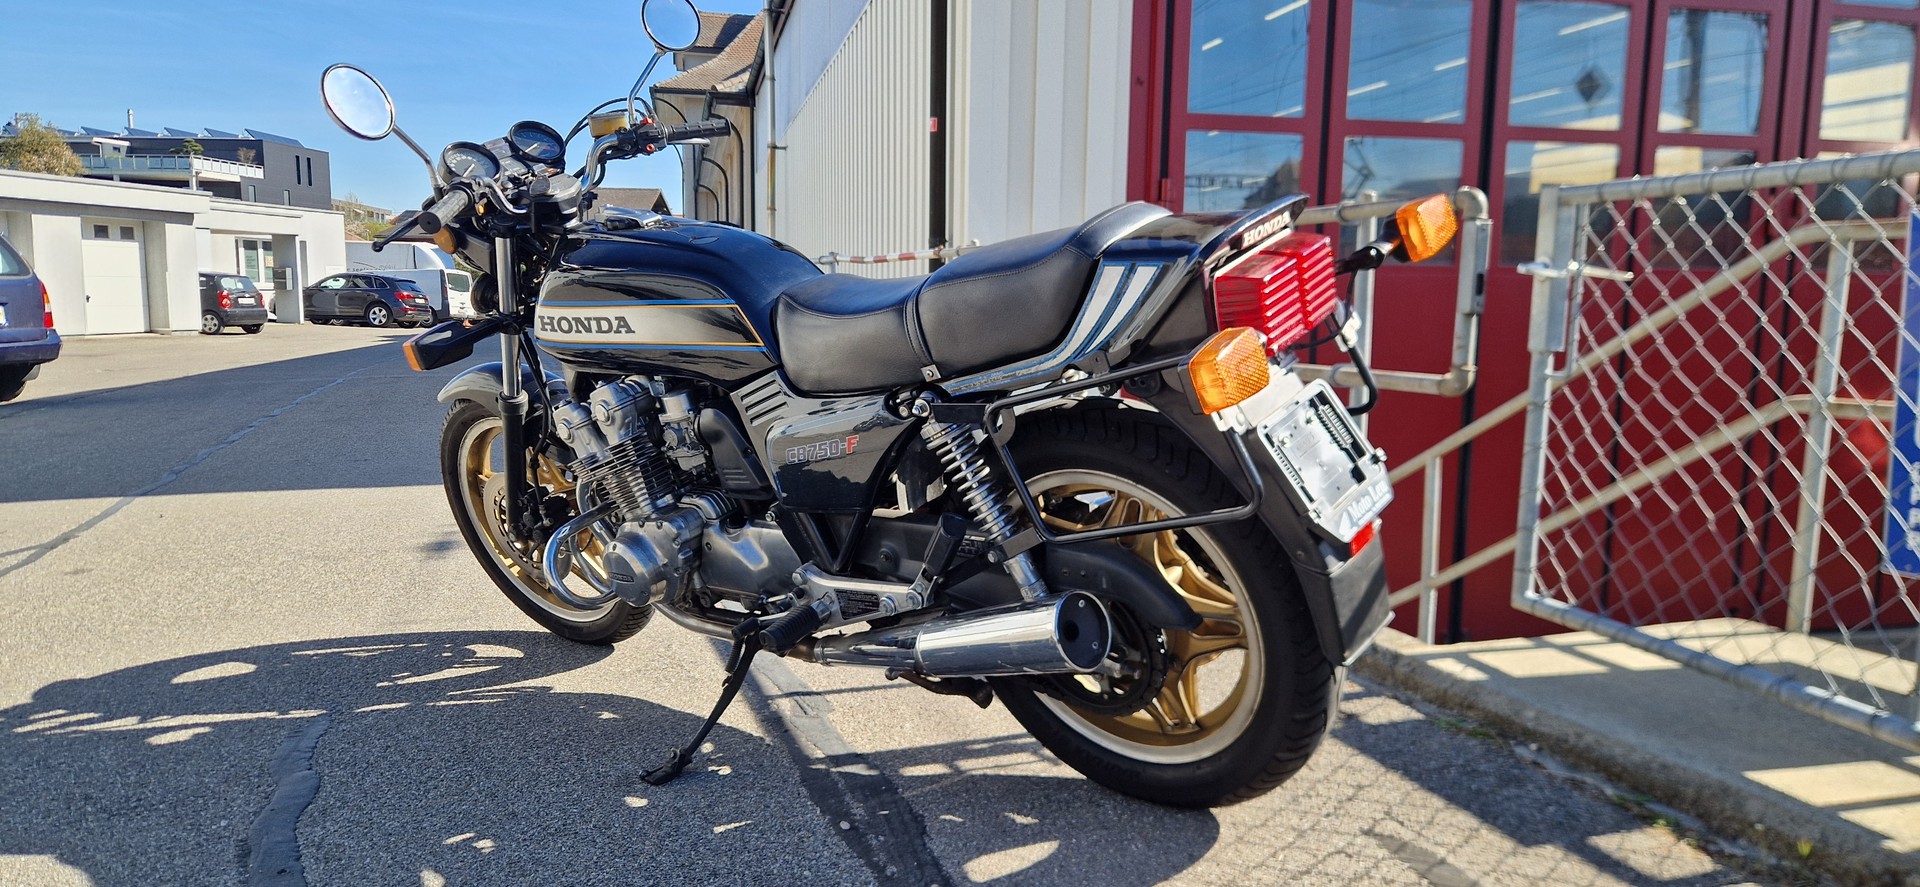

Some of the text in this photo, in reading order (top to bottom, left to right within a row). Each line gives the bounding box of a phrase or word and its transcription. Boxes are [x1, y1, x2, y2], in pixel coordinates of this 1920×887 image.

[1242, 210, 1291, 247] HONDA
[538, 315, 636, 334] HONDA
[786, 434, 860, 465] CB750-F
[1347, 495, 1373, 522] Moto
